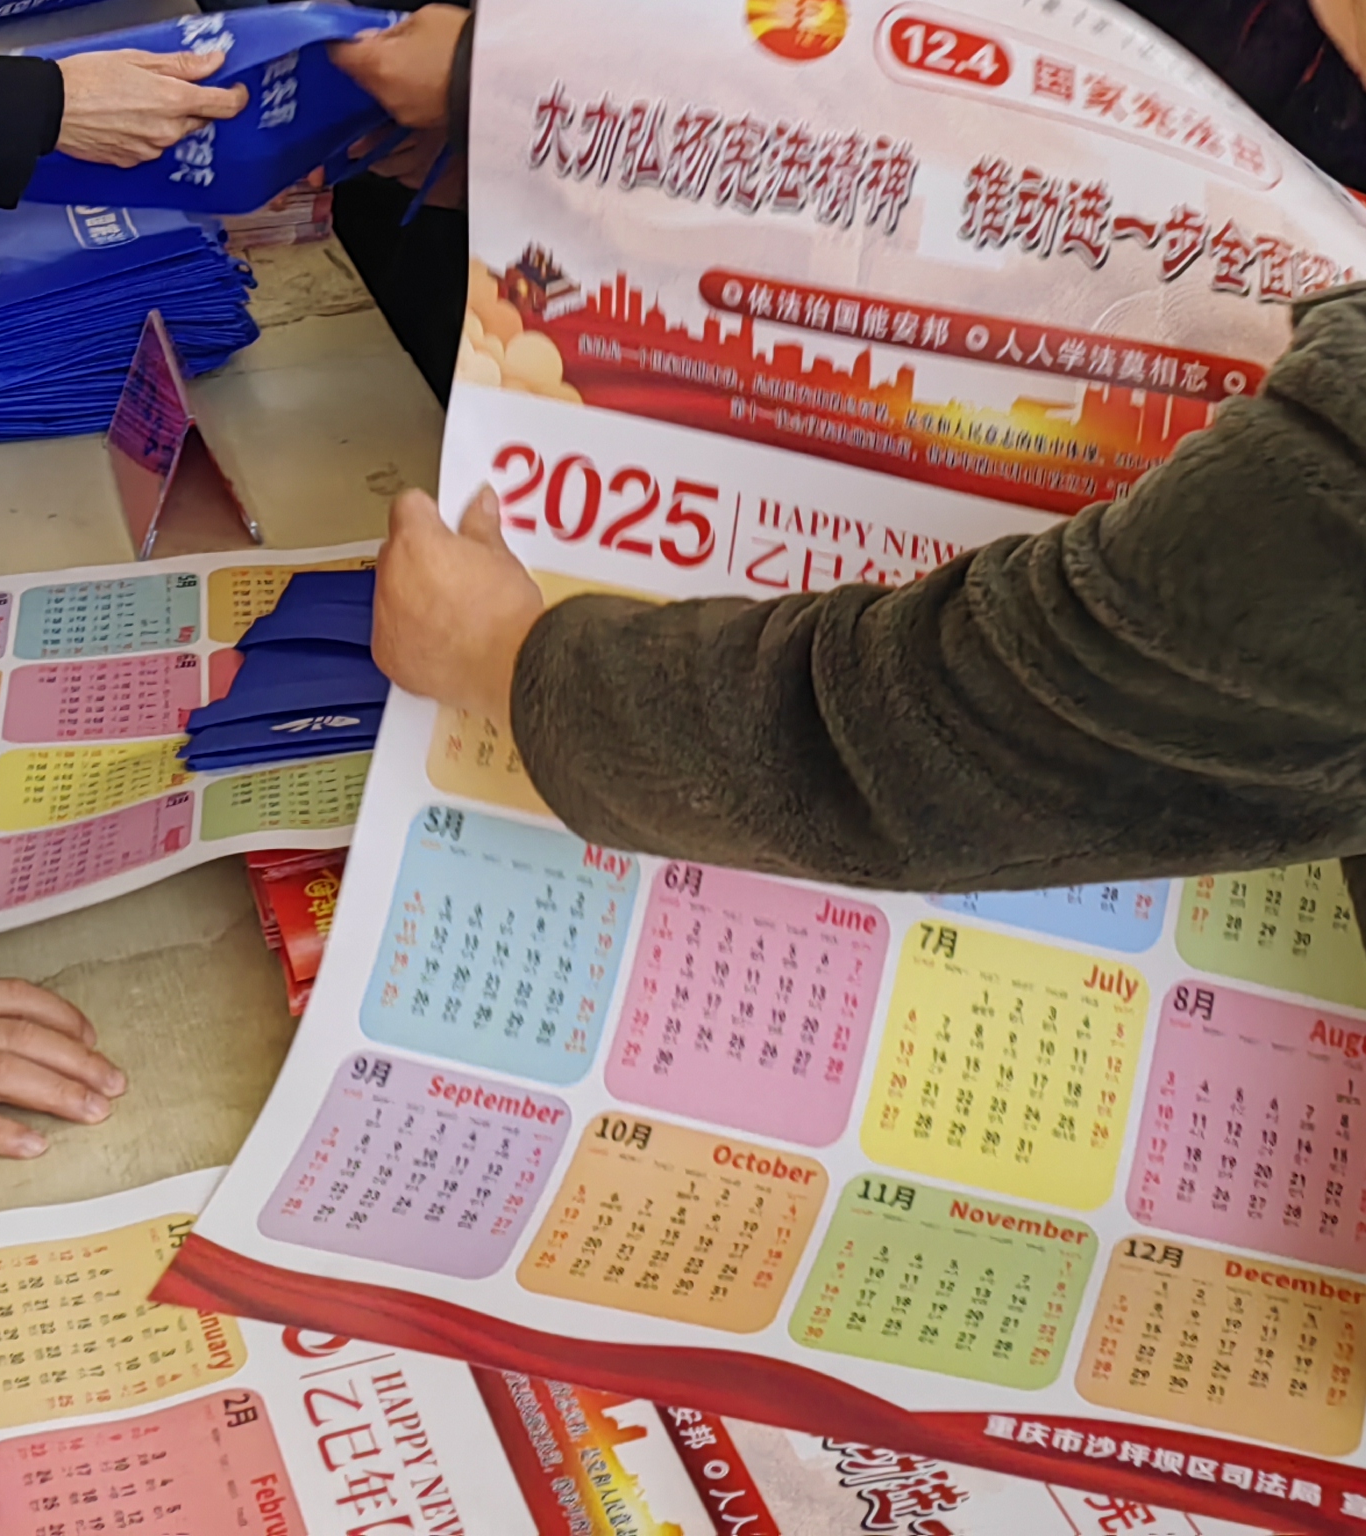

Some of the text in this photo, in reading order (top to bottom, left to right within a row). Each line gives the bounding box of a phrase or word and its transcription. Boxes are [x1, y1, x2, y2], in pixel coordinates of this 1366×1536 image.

[529, 78, 919, 236] 大力弘扬宪法精神
[747, 282, 1210, 394] 依法治国能安邦 人人学法莫相忘
[491, 442, 720, 567] 2025
[759, 497, 875, 551] HAPPY
[582, 843, 633, 882] May
[664, 864, 703, 897] 6月
[815, 898, 878, 935] June
[919, 922, 958, 959] 7月
[1083, 964, 1139, 1004] July
[1173, 986, 1215, 1021] 8月
[351, 1057, 392, 1088] 9月
[427, 1074, 565, 1126] September
[595, 1117, 652, 1151] 10月
[712, 1144, 818, 1186] October
[857, 1179, 916, 1211] 11月
[949, 1199, 1089, 1246] November
[1124, 1239, 1184, 1269] 12月
[197, 1308, 234, 1371] anuary
[223, 1392, 259, 1429] 2月
[372, 1368, 439, 1471] HAPPY
[983, 1413, 1323, 1508] 重庆市沙坪坝区司法局
